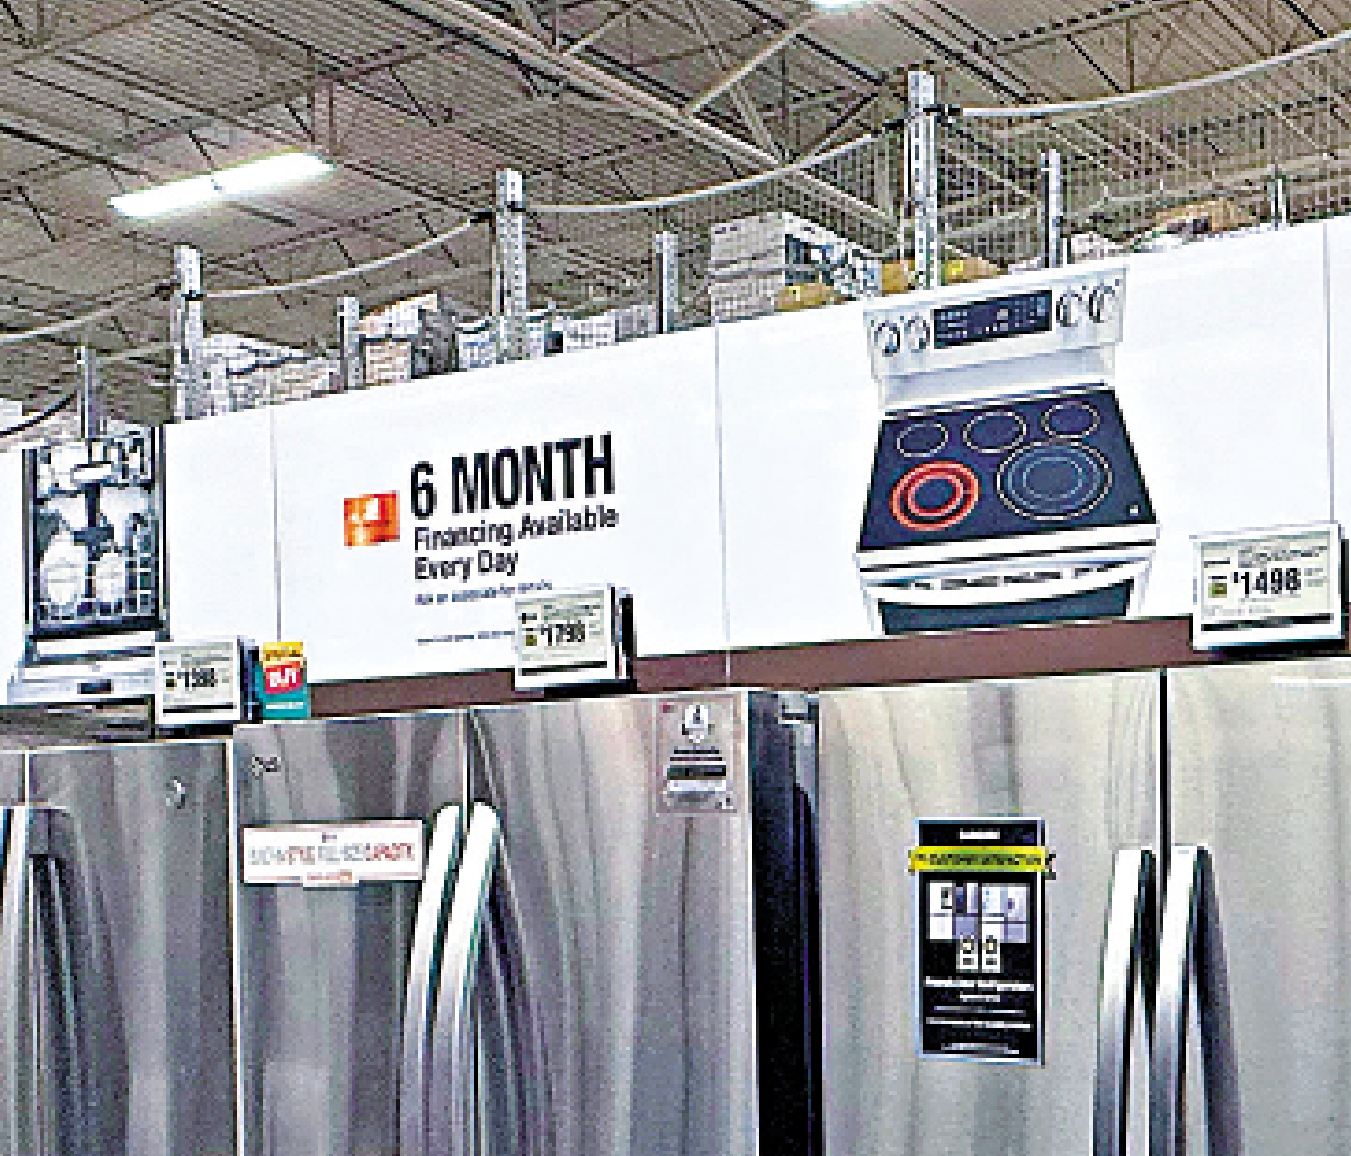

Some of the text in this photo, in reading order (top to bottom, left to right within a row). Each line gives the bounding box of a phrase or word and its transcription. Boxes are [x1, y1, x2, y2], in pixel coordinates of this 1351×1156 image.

[411, 431, 617, 520] 6 MONTH
[415, 505, 620, 553] Financing Available
[415, 550, 519, 583] Every Day
